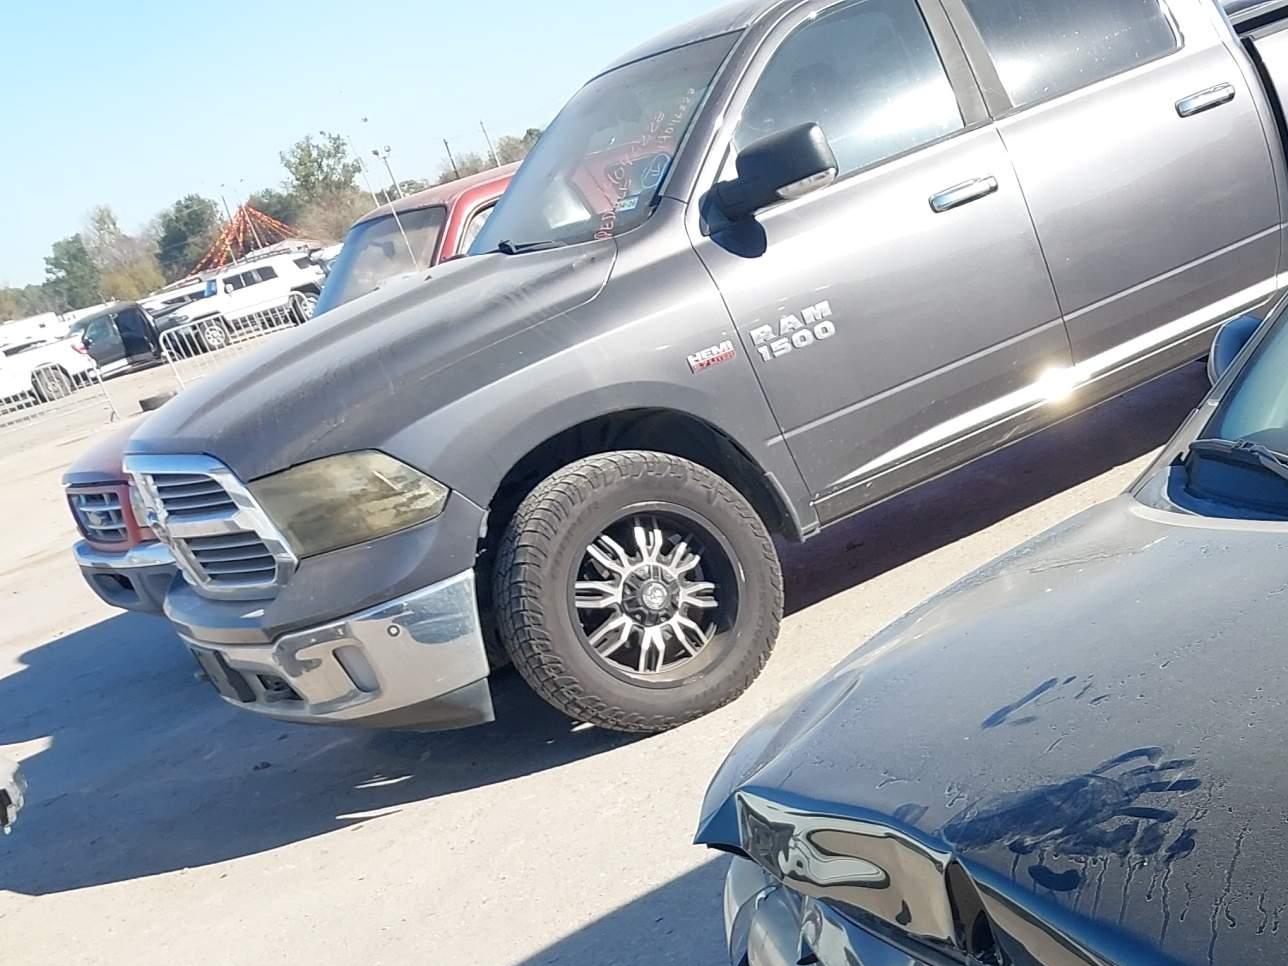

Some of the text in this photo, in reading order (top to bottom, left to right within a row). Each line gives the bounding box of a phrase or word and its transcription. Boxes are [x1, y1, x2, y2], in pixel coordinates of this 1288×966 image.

[749, 299, 833, 347] RAM
[756, 320, 837, 363] 1500
[687, 340, 735, 364] HEMI
